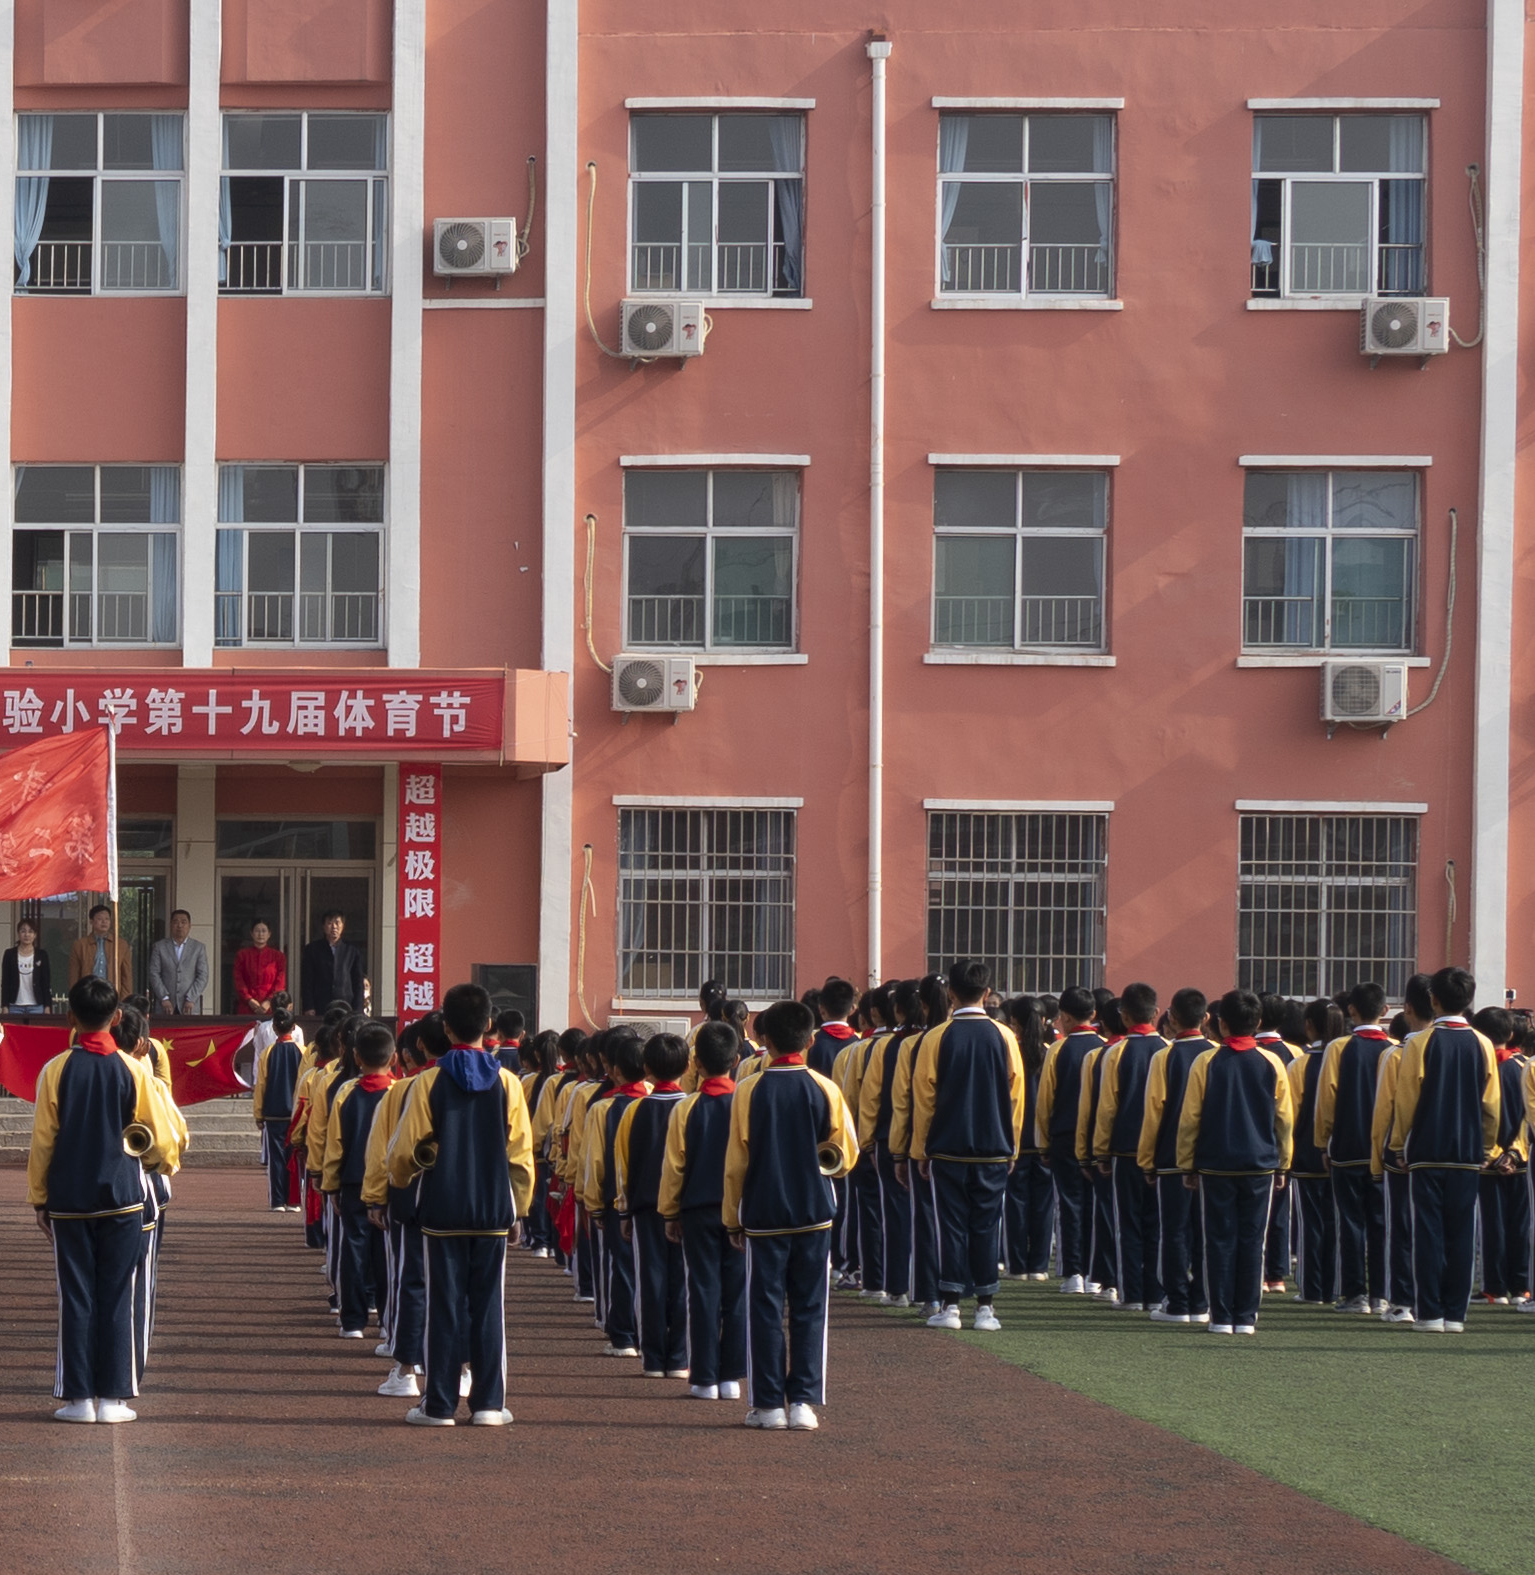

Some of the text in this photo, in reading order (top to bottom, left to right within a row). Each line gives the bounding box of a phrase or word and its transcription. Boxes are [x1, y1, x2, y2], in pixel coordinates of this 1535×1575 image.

[402, 774, 436, 1027] 超越极限 超越
